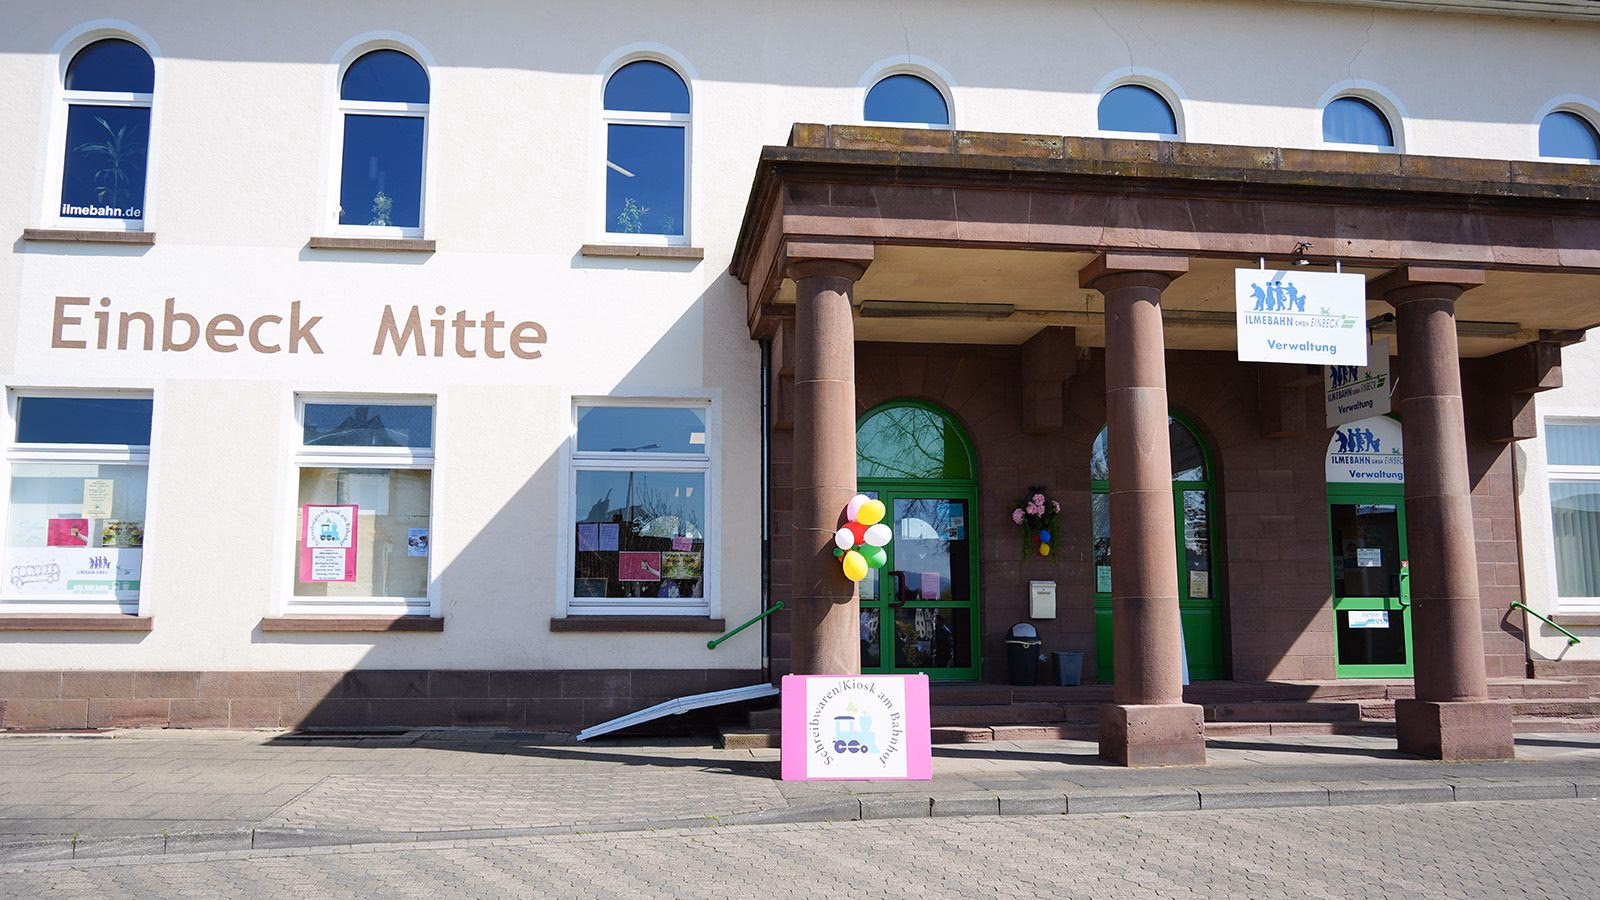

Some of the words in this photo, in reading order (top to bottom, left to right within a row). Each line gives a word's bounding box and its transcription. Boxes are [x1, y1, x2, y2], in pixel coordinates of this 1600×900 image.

[62, 203, 141, 217] ilmebahn.de
[50, 296, 324, 355] Einbeck
[372, 304, 548, 360] Mitte
[1245, 314, 1294, 327] ILMEBAHN
[1310, 317, 1341, 329] EINBECK
[1267, 339, 1337, 355] Verwaltung
[1328, 388, 1352, 402] ILMEBAHN
[1338, 400, 1373, 414] Verwaltung
[1331, 456, 1371, 465] ILMEBAHN
[1384, 456, 1404, 465] EINBEC
[1349, 470, 1403, 481] Verwaltung
[877, 691, 893, 709] am
[809, 679, 877, 766] Schreibwaren/Kiosk
[879, 712, 903, 769] Bahnhof
